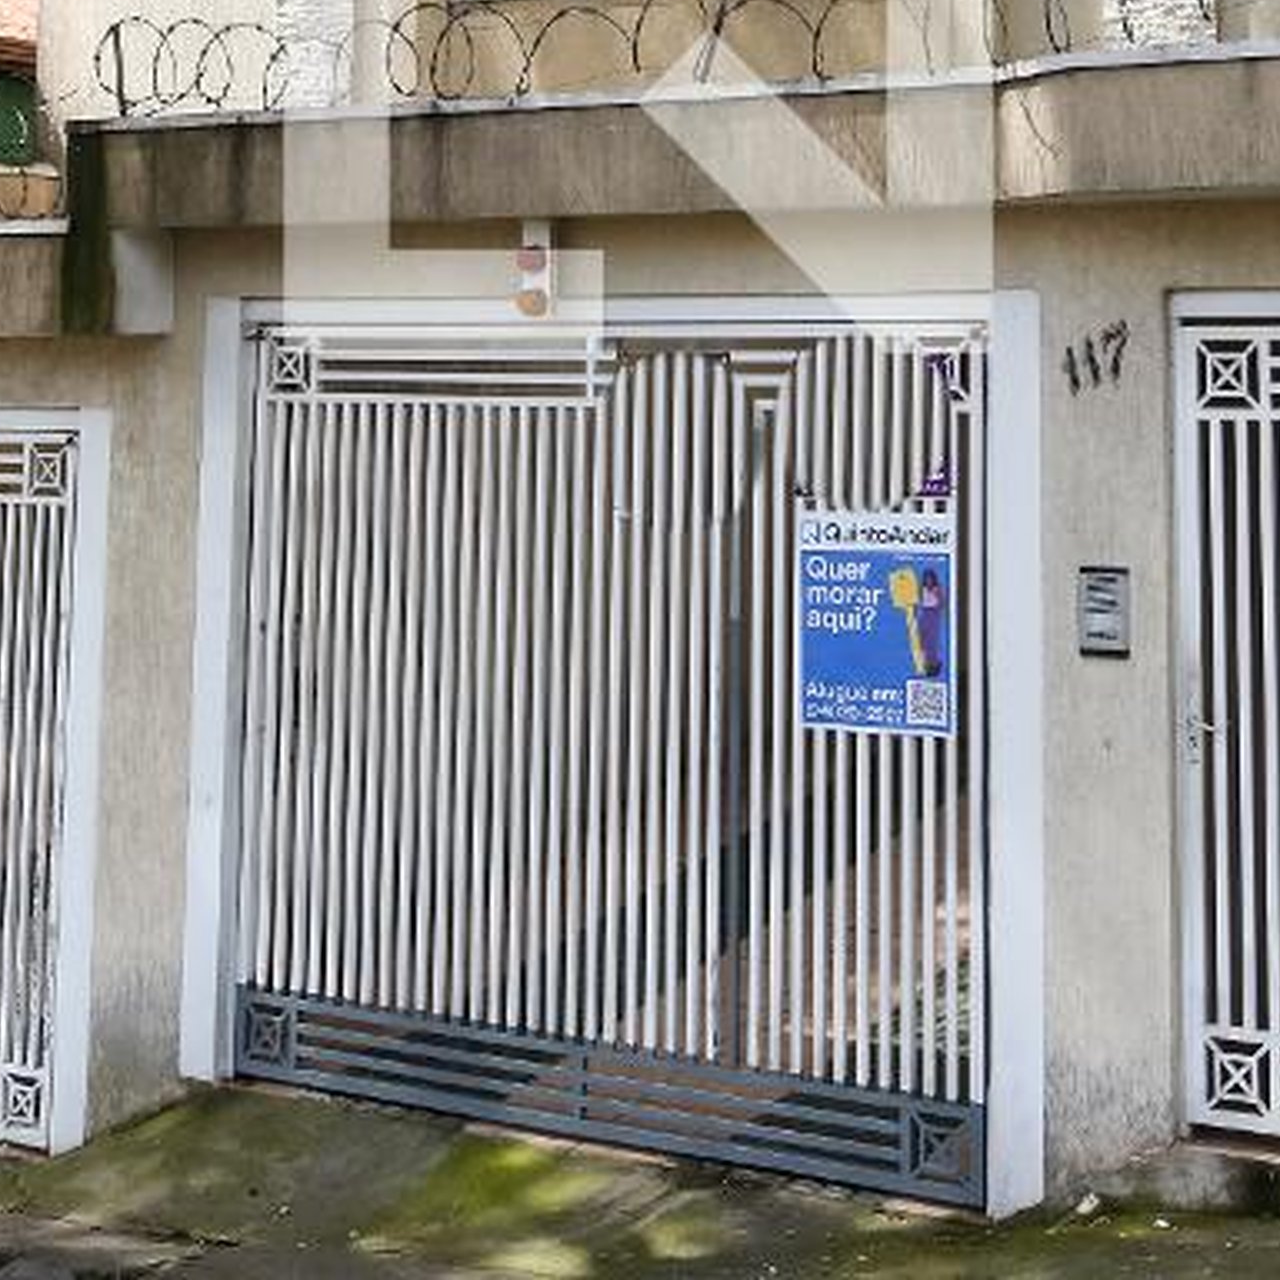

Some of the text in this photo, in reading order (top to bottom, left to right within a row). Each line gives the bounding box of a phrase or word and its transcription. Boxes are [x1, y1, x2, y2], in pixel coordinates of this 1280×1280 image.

[1064, 319, 1129, 397] 117
[806, 556, 870, 581] Quer
[807, 585, 884, 605] morar
[806, 606, 876, 634] aqui?
